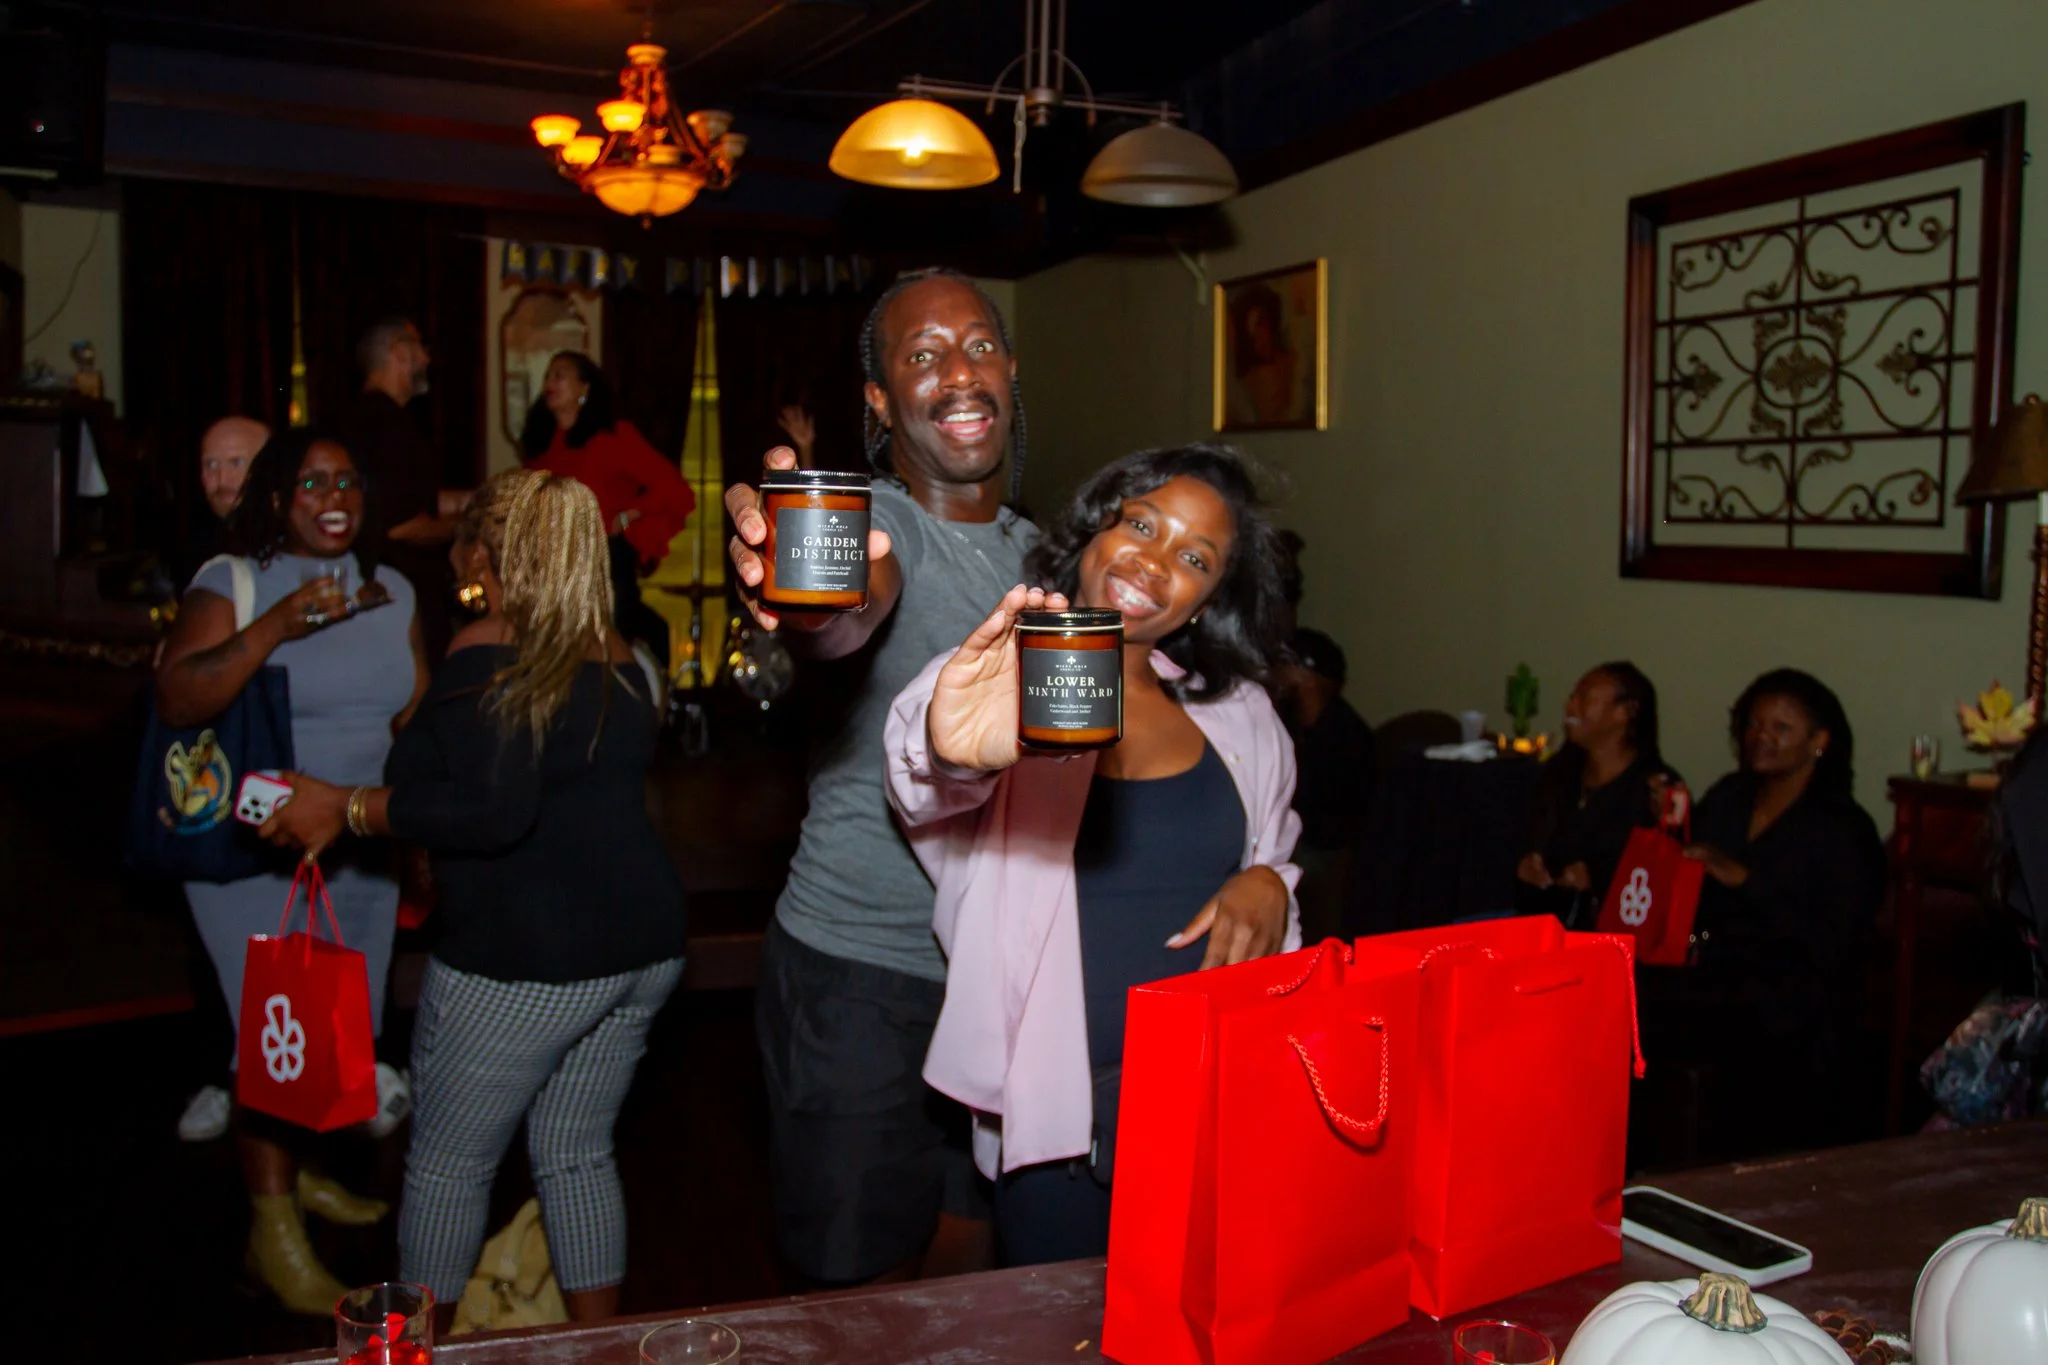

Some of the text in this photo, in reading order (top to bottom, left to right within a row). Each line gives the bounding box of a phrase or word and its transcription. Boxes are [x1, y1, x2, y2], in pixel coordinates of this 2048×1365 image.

[803, 535, 858, 548] GARDEN
[791, 547, 865, 561] DISTRICT
[1046, 675, 1096, 687] LOWER
[1028, 686, 1114, 698] NINTH WARD
